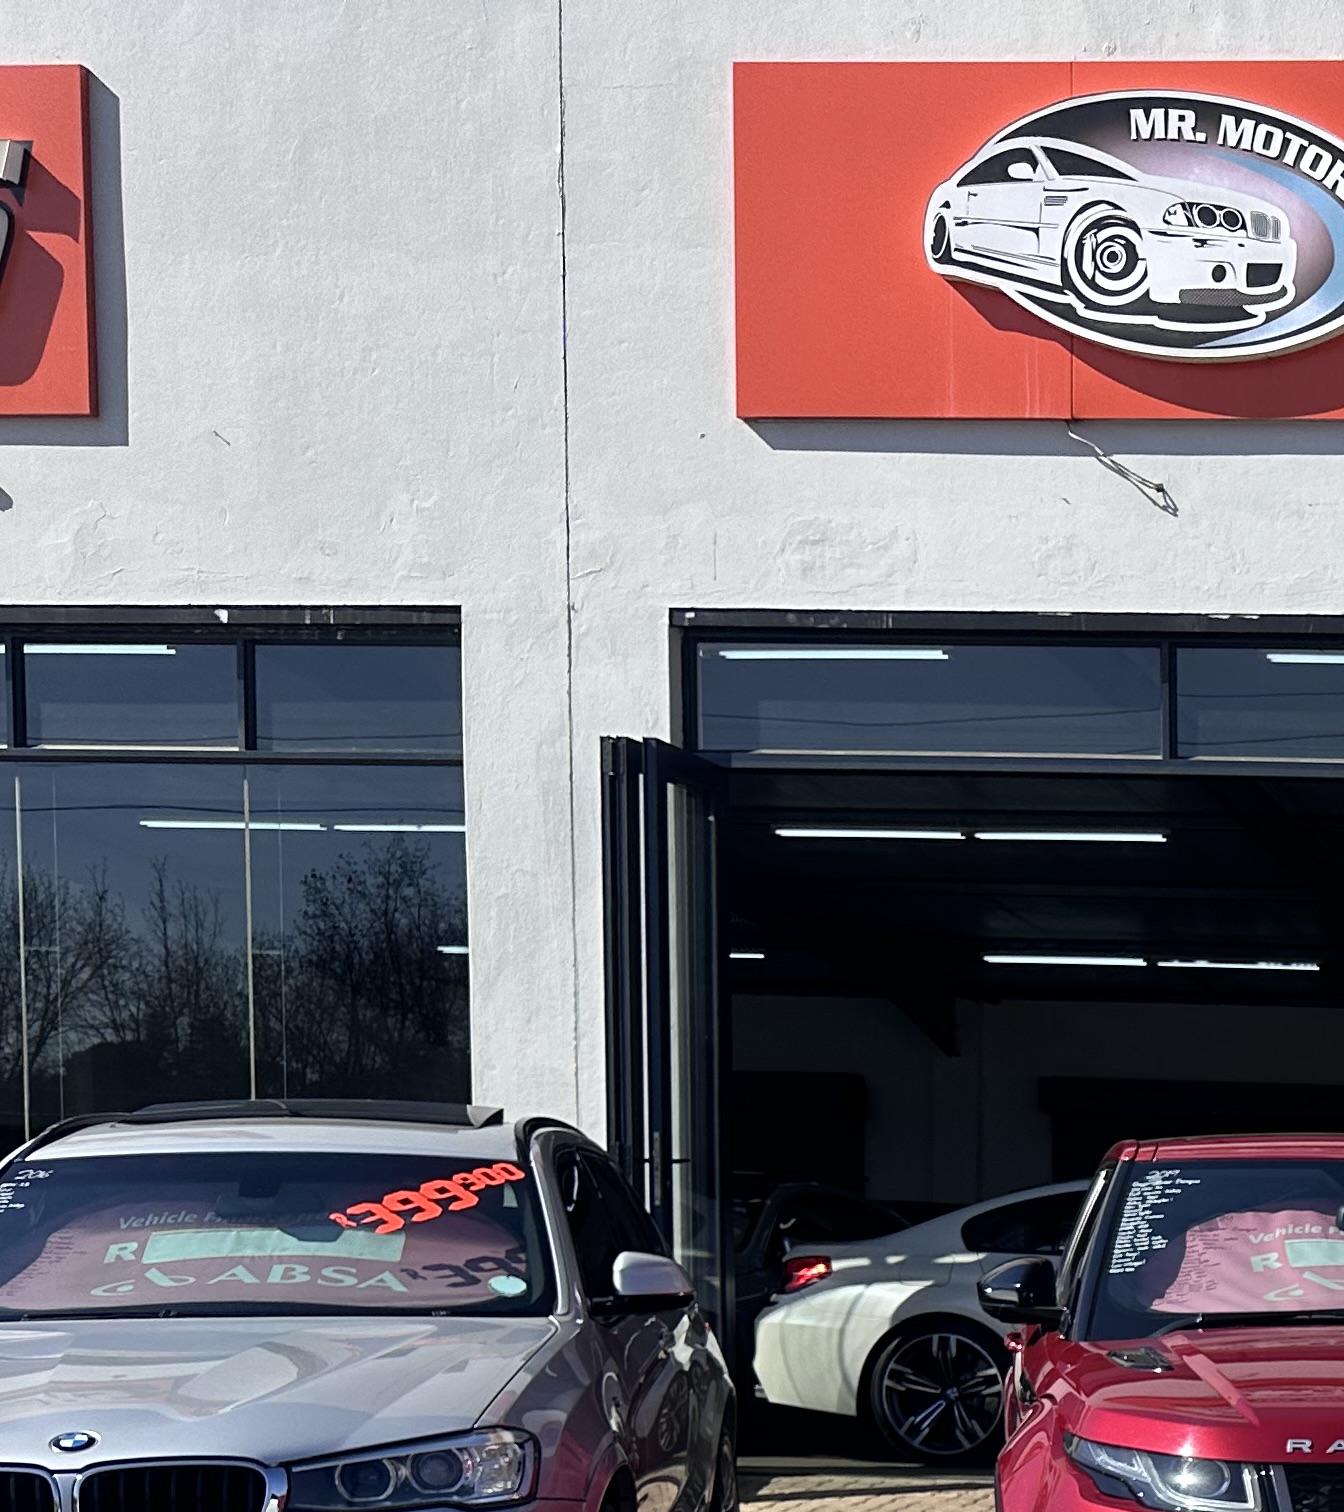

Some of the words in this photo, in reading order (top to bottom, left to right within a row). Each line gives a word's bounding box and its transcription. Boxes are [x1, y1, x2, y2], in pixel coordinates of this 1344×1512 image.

[1130, 108, 1206, 143] MR.
[118, 1209, 198, 1230] Vehicle
[1249, 1223, 1323, 1245] Vehicle
[103, 1241, 139, 1264] R
[1251, 1252, 1283, 1273] R
[207, 1264, 409, 1293] ABSA
